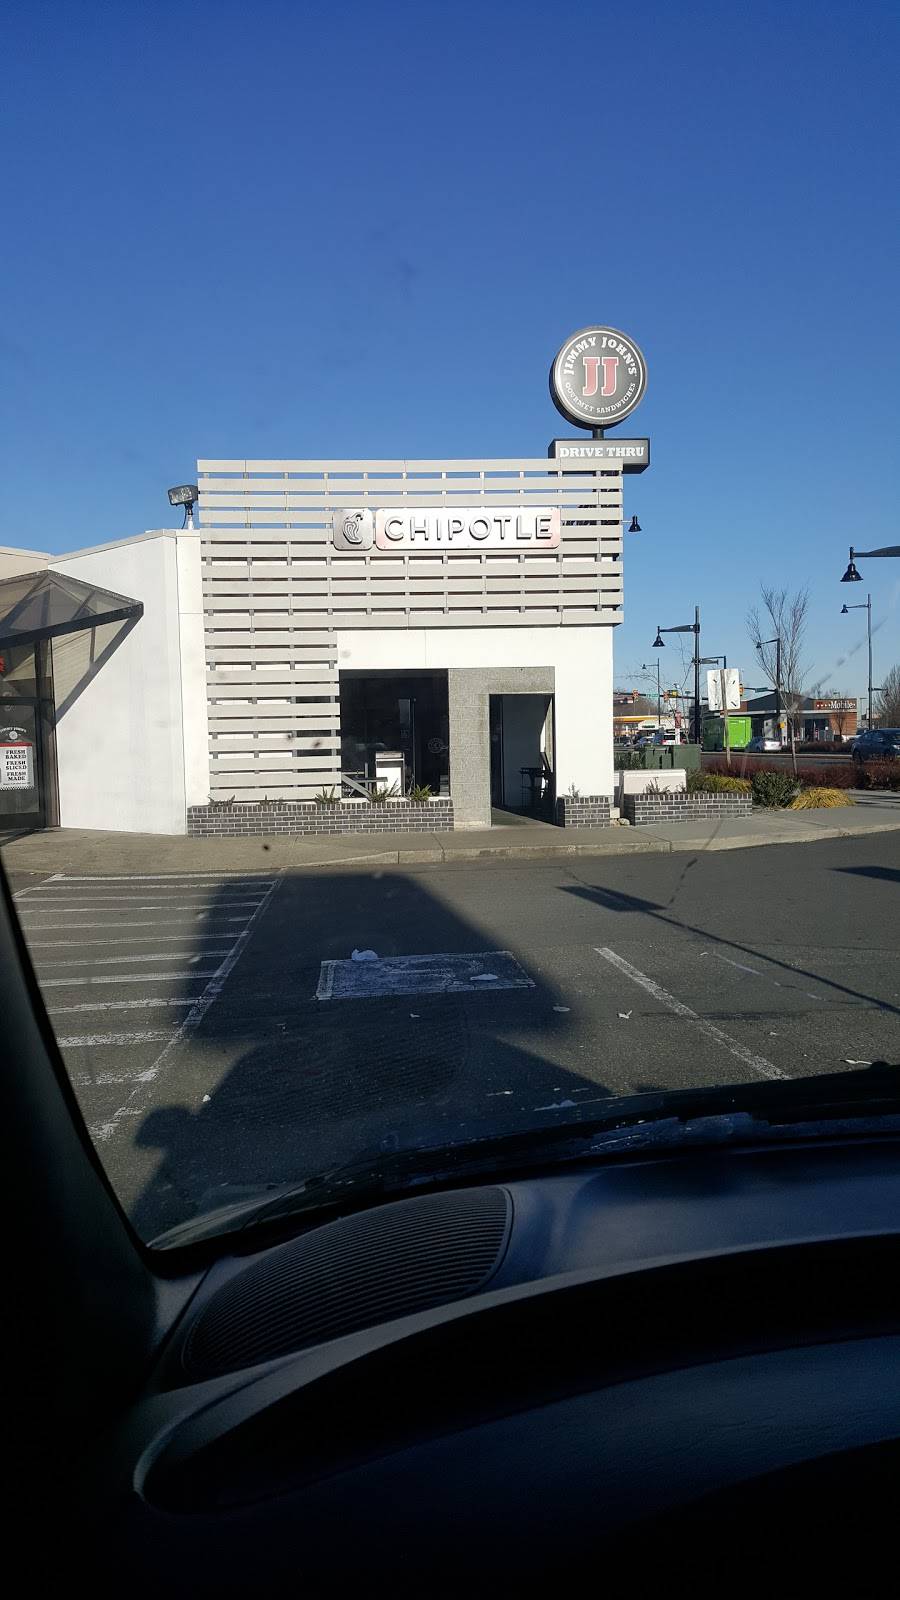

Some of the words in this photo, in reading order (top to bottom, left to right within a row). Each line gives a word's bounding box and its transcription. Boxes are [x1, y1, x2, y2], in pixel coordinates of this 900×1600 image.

[563, 336, 597, 375] JIMMY
[601, 336, 637, 375] JOHN'S
[582, 356, 619, 396] JJ
[565, 382, 594, 412] GOURMET
[596, 382, 636, 414] SANDWICHES
[560, 447, 603, 458] DRIVE
[606, 447, 645, 457] THRU
[384, 514, 553, 541] CHIPOTLE
